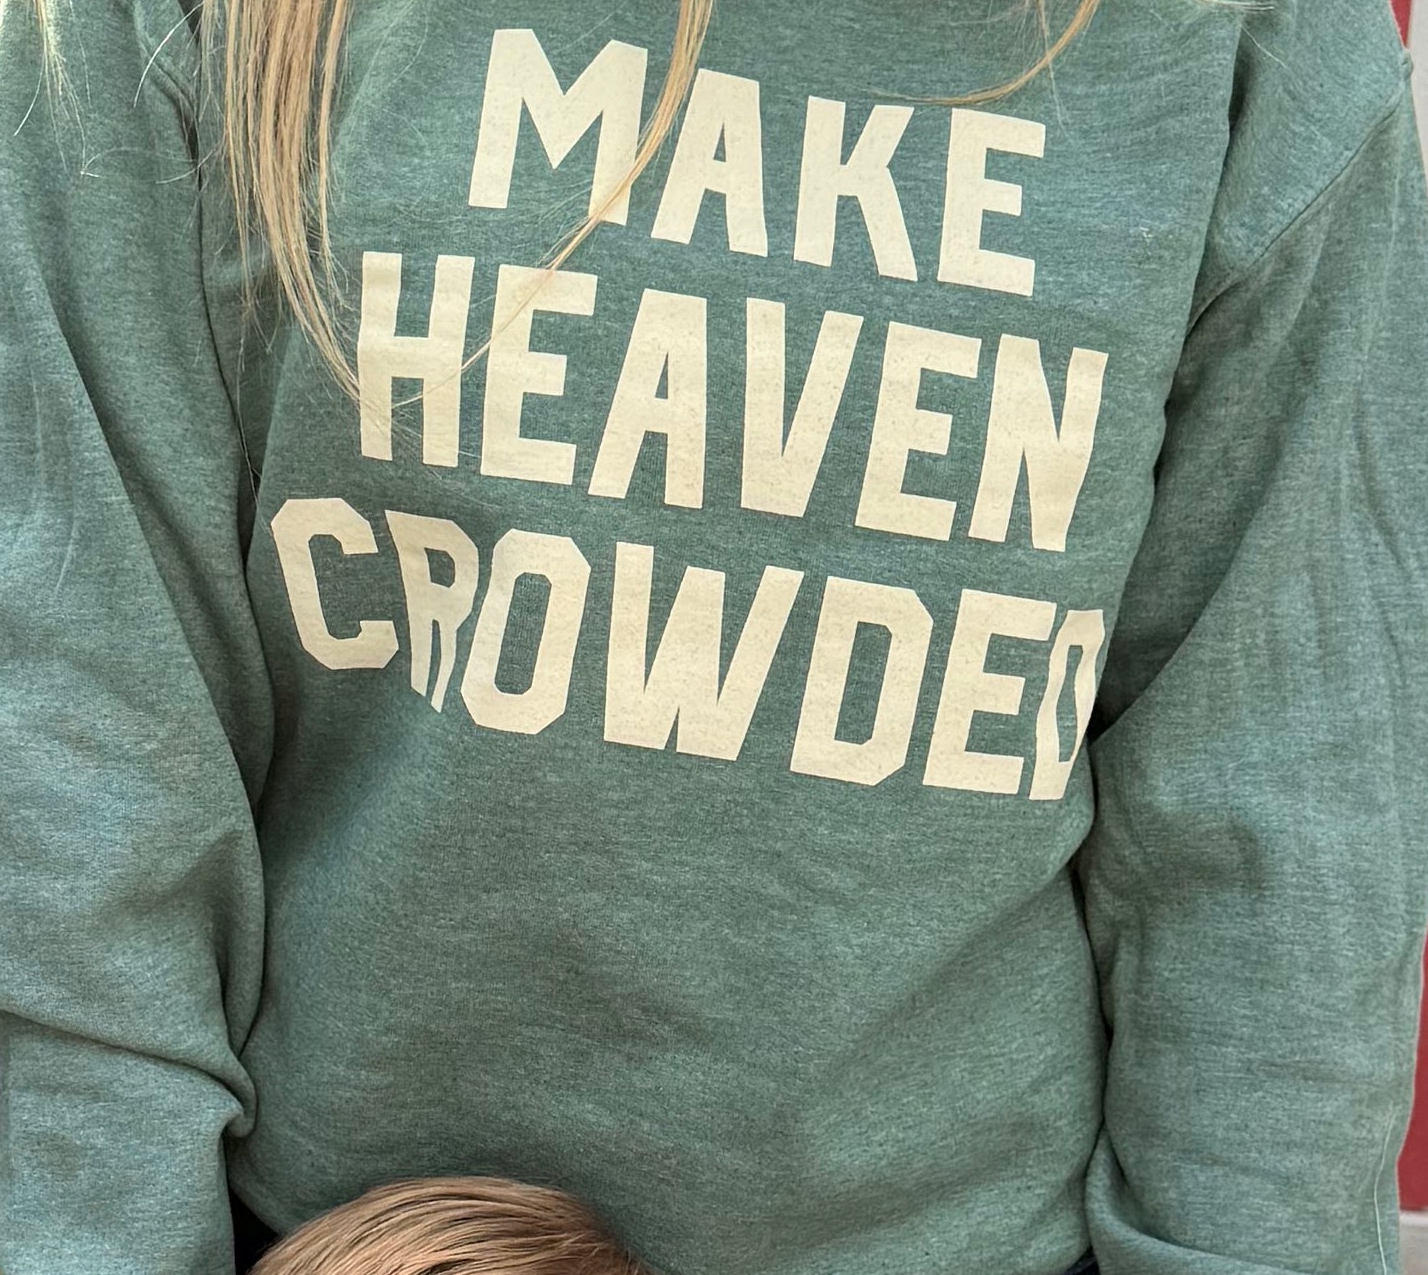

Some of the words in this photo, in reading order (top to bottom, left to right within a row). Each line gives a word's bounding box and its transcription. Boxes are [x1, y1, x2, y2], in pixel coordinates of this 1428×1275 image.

[468, 28, 1046, 297] MAKE
[356, 251, 1109, 553] HEAVEN
[270, 497, 1106, 801] CROWDED
